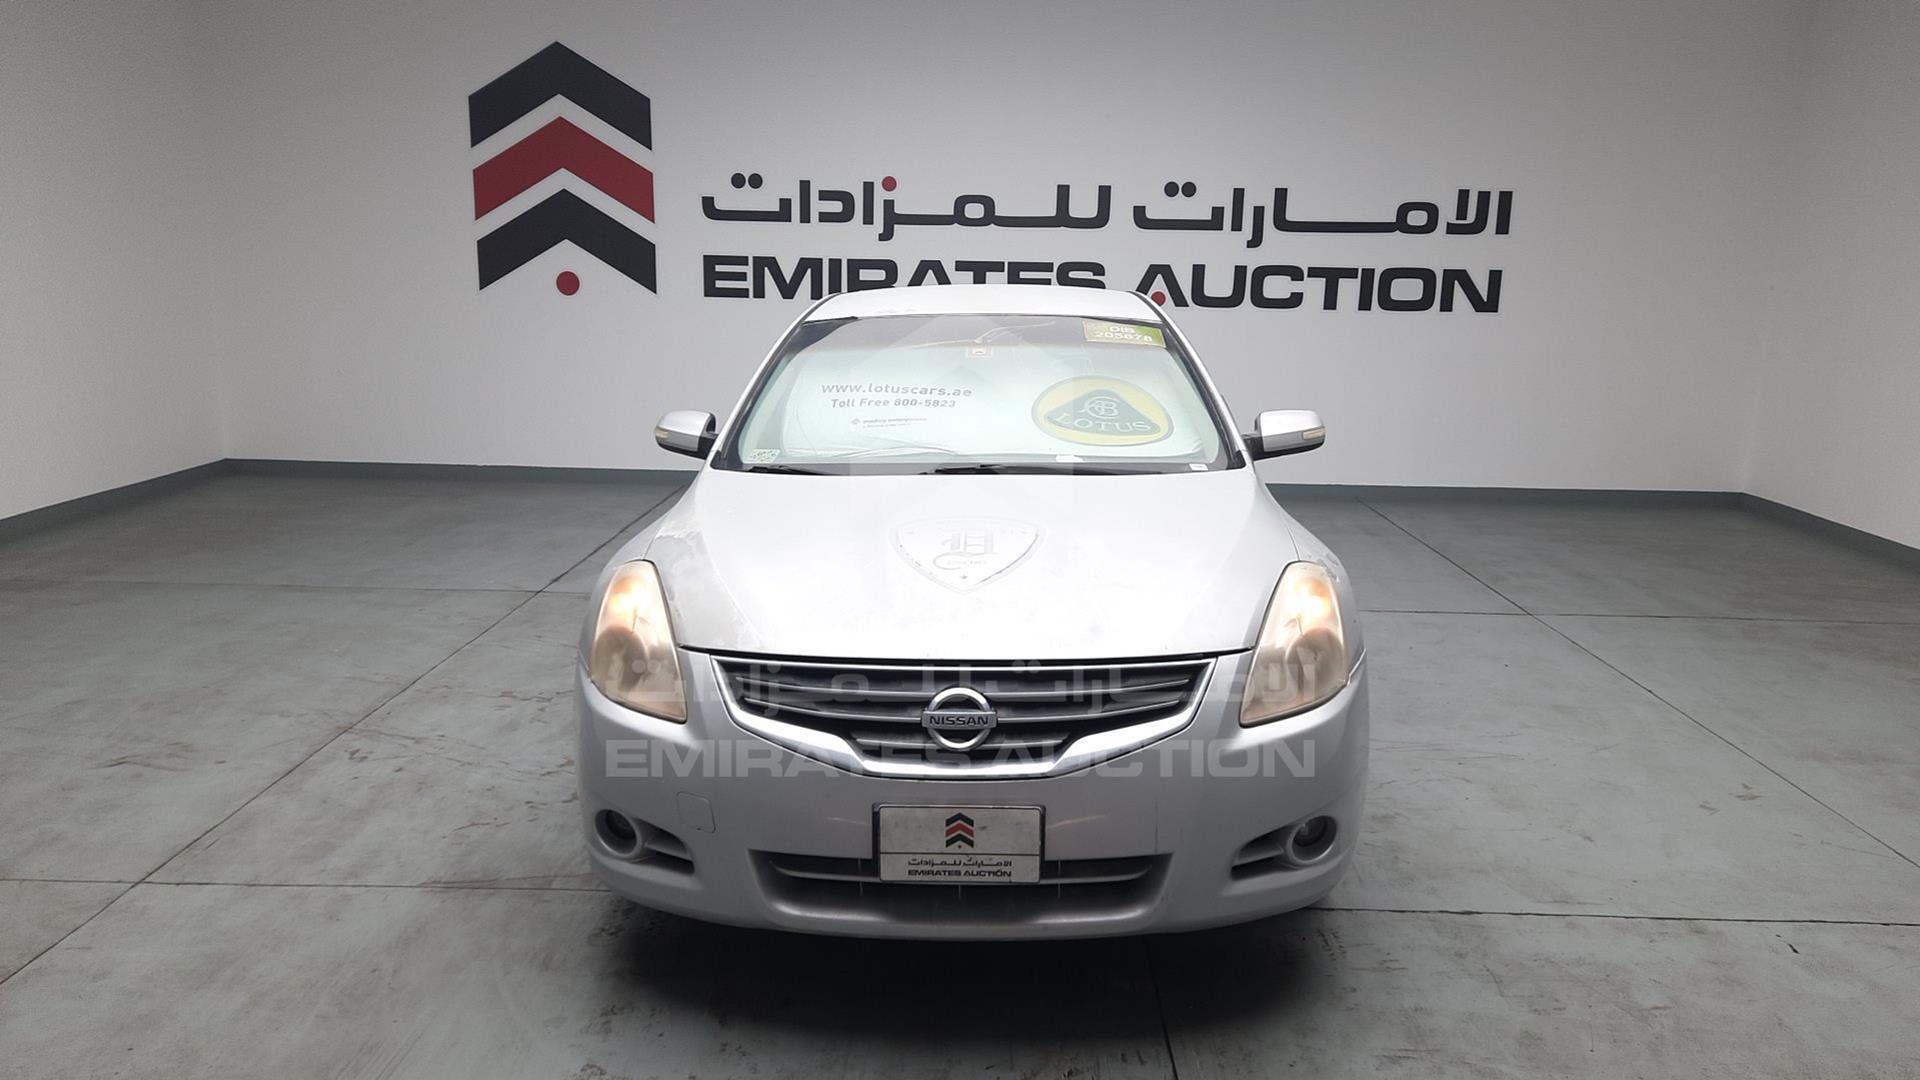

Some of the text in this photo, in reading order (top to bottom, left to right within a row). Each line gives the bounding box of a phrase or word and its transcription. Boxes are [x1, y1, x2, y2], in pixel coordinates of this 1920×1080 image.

[701, 172, 1112, 241] للمزادات
[1136, 263, 1503, 313] AUCTION
[821, 383, 973, 397] www.lotuscars.ae
[831, 398, 956, 408] Toll Free 800-5823
[1054, 412, 1150, 433] LOTUS
[929, 715, 989, 725] NISSAN
[908, 869, 1012, 878] EMIRATES AUCTION
